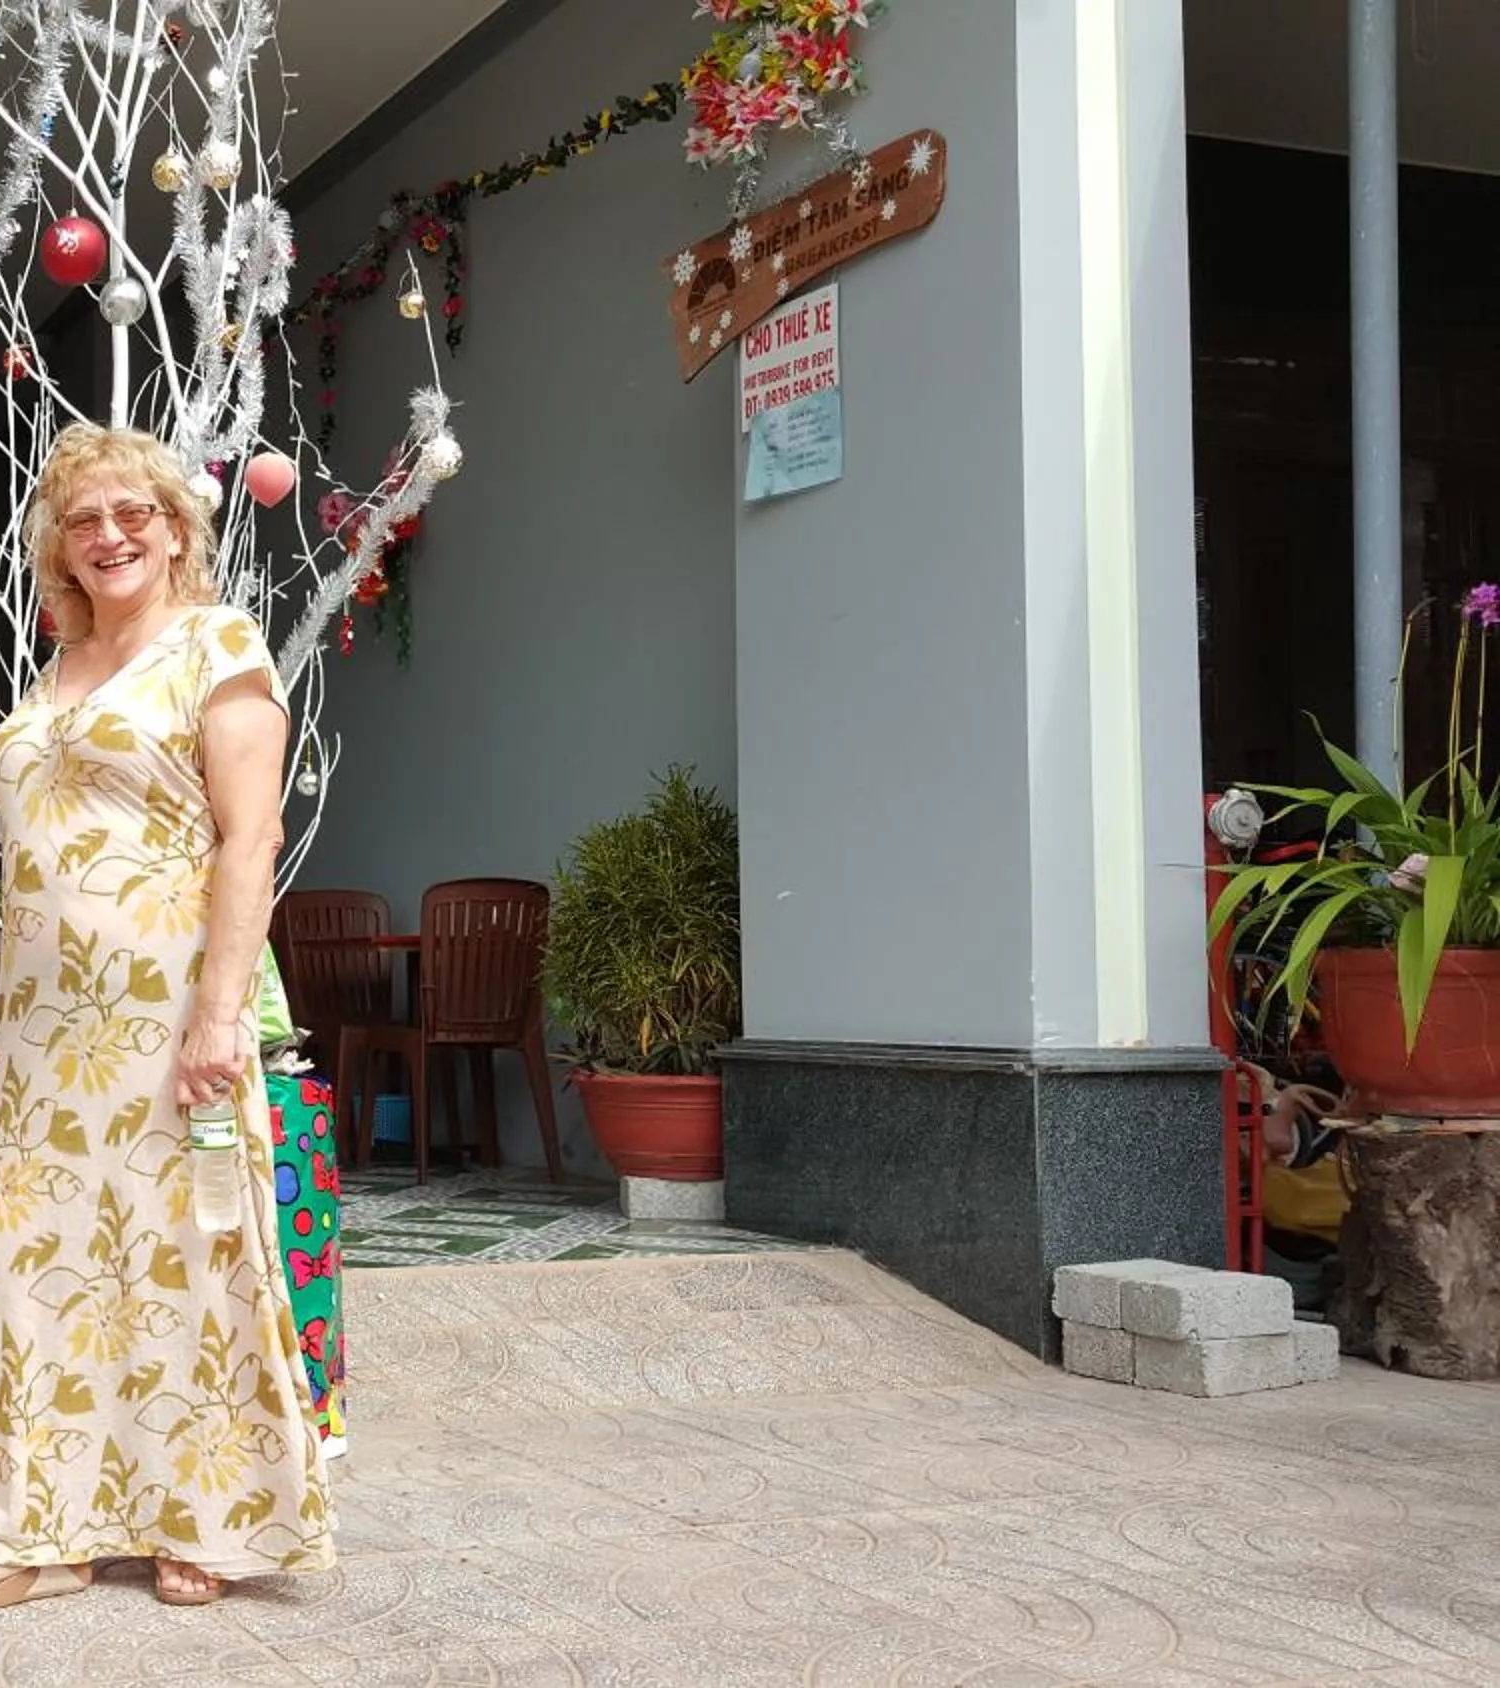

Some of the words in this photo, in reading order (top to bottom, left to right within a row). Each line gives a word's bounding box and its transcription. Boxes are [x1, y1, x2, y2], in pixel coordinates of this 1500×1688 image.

[784, 217, 880, 277] BREAKFAST
[745, 323, 772, 360] CHO
[775, 302, 808, 348] THUÊ
[814, 301, 831, 335] XE
[793, 356, 809, 376] FOR
[812, 347, 833, 368] RENT
